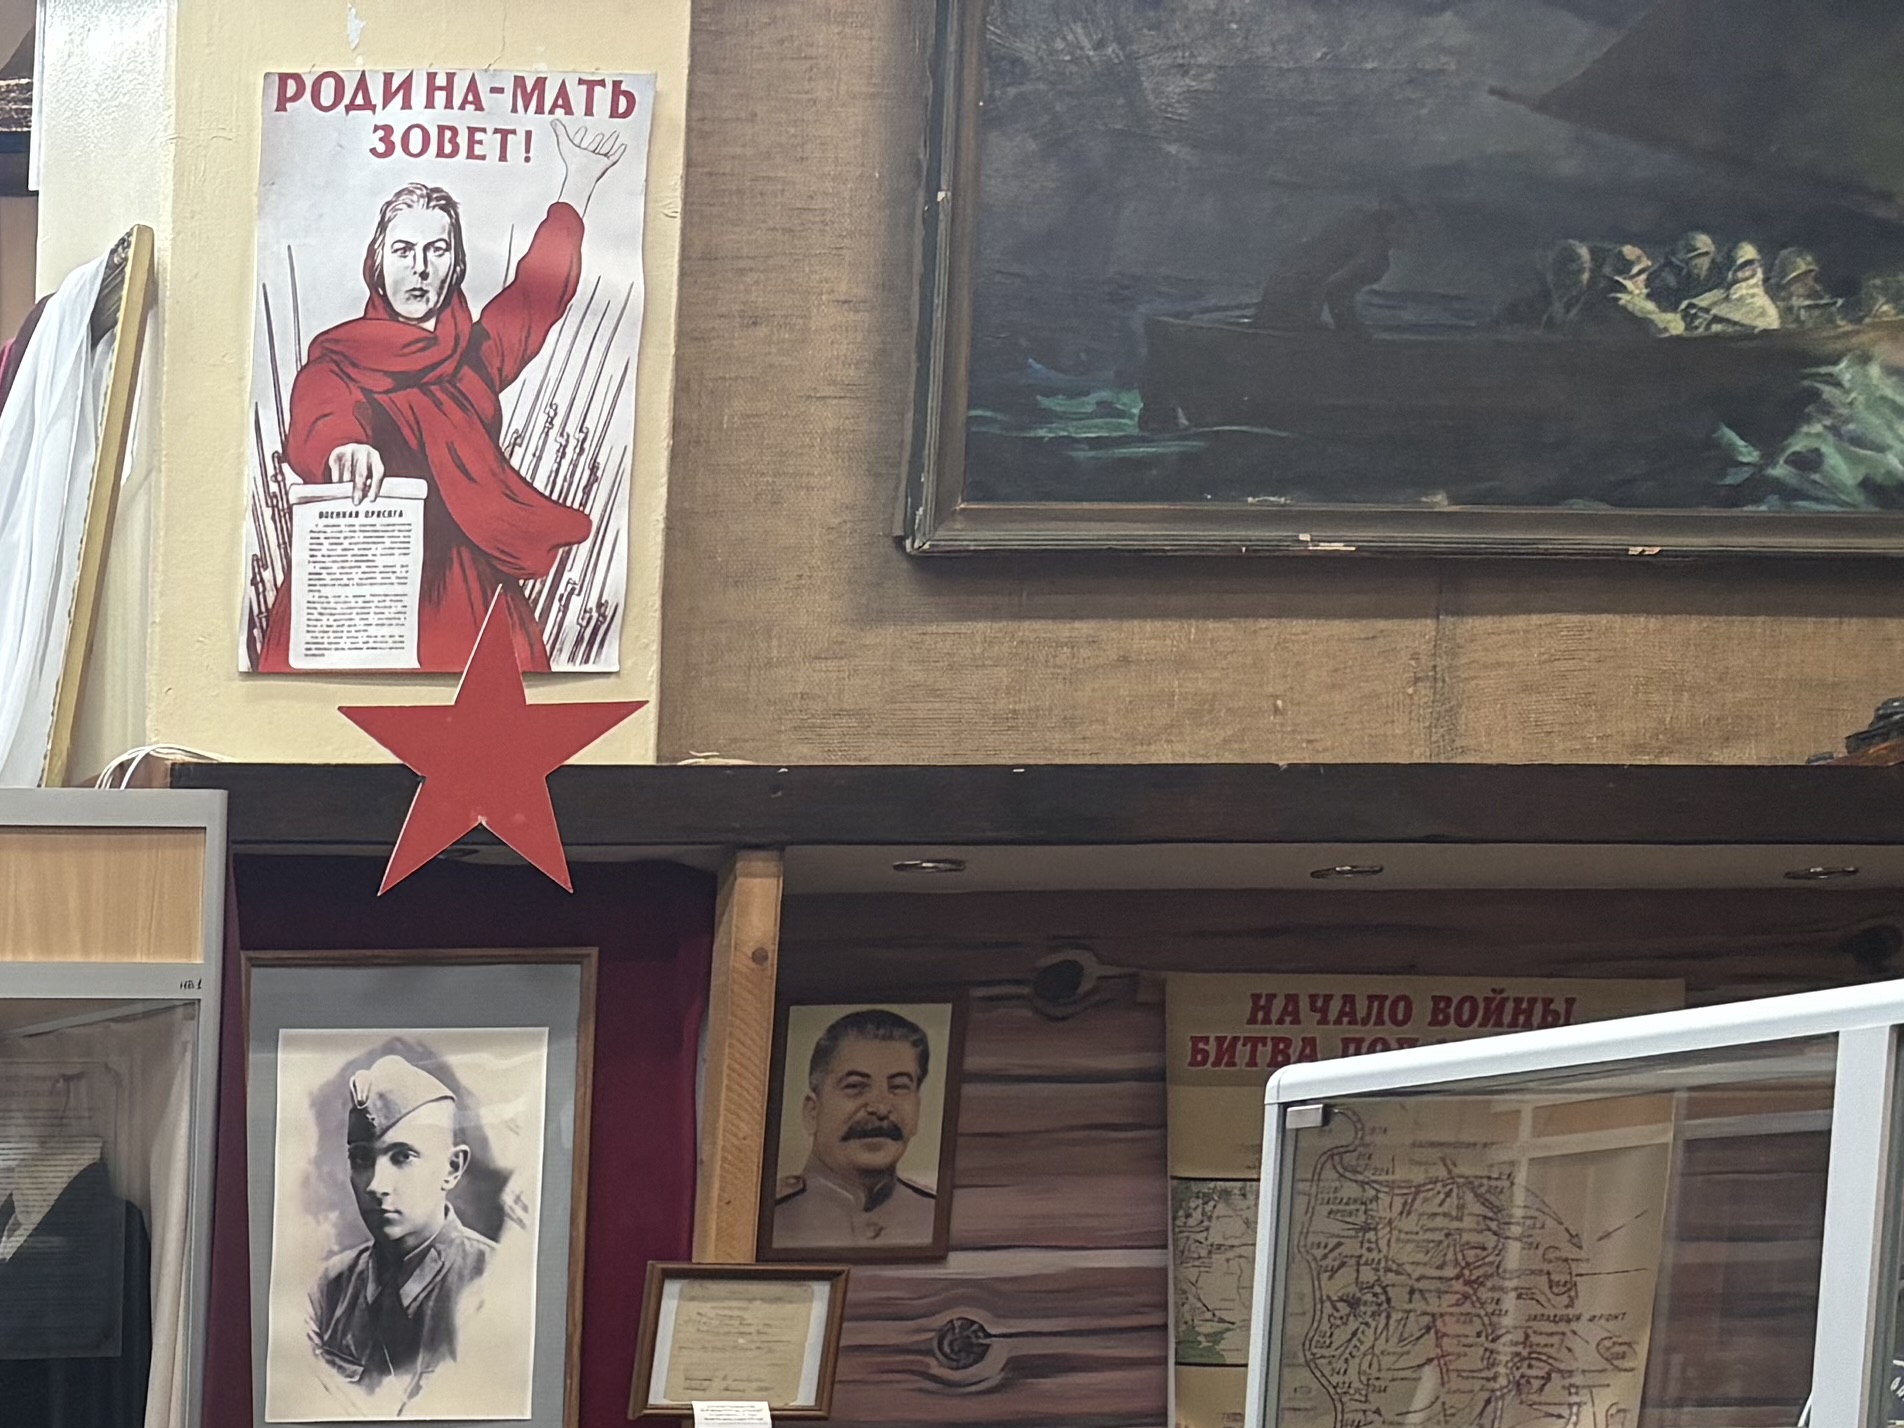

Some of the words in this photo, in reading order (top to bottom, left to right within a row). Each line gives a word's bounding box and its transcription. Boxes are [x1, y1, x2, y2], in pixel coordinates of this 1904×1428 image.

[274, 71, 637, 119] РОДИНА-МАТЬ
[369, 123, 533, 164] ЗОВЕТ!
[1245, 992, 1414, 1027] НАЧАЛО
[1427, 988, 1577, 1029] ВОЙНЫ
[1187, 1035, 1320, 1068] БИТВА
